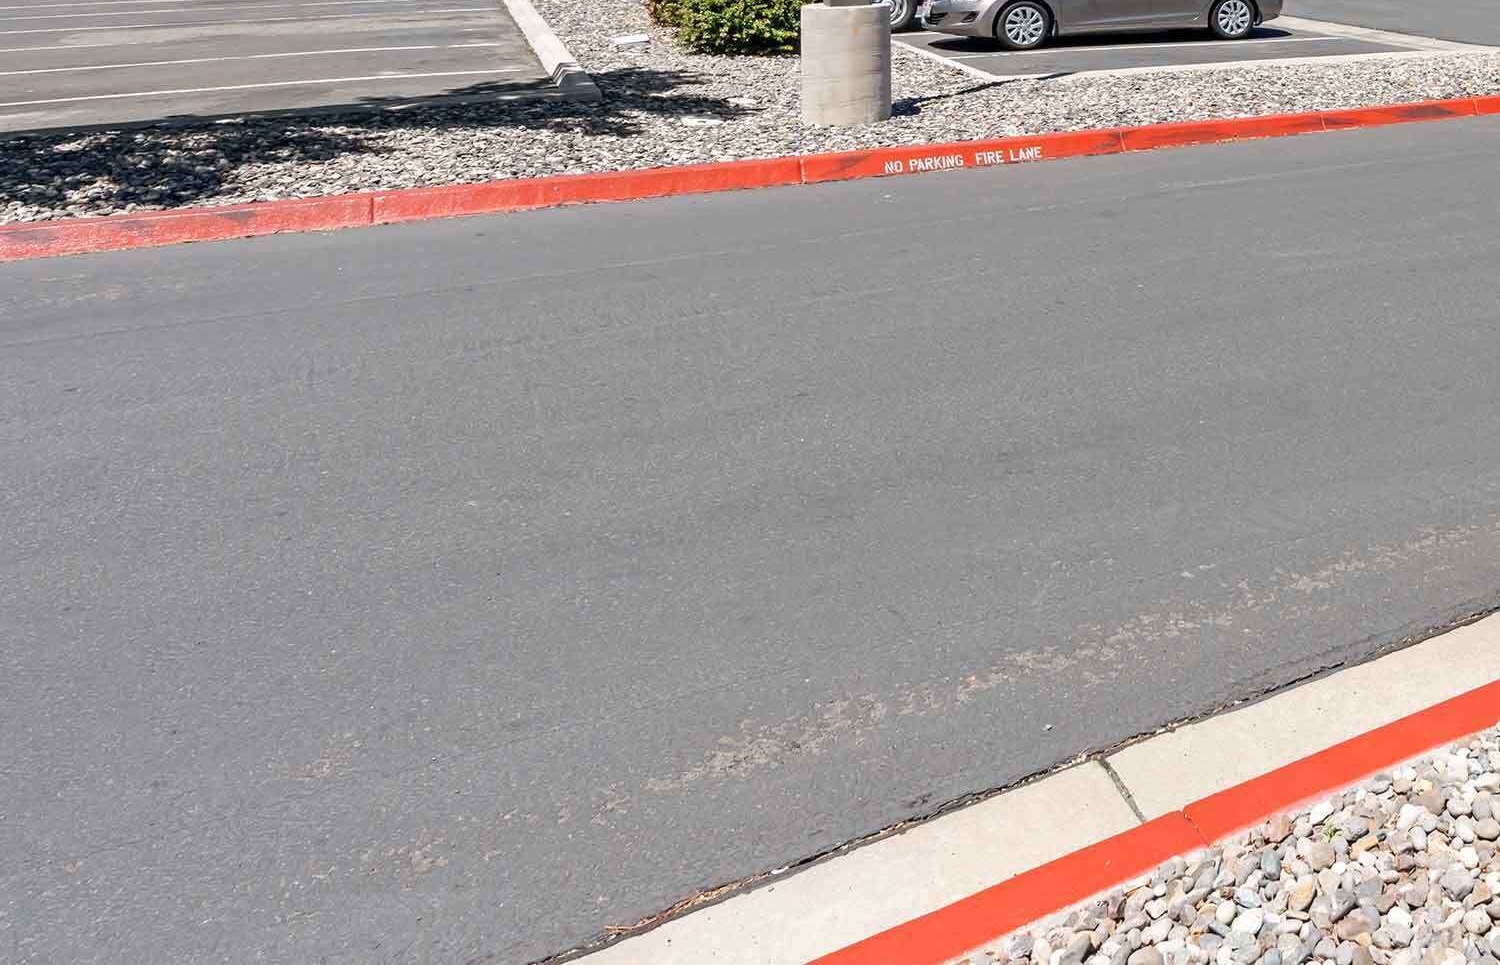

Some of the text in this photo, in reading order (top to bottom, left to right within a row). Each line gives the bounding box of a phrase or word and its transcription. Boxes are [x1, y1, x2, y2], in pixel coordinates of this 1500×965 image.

[884, 146, 1042, 174] NO PARKING FIRE LANE
